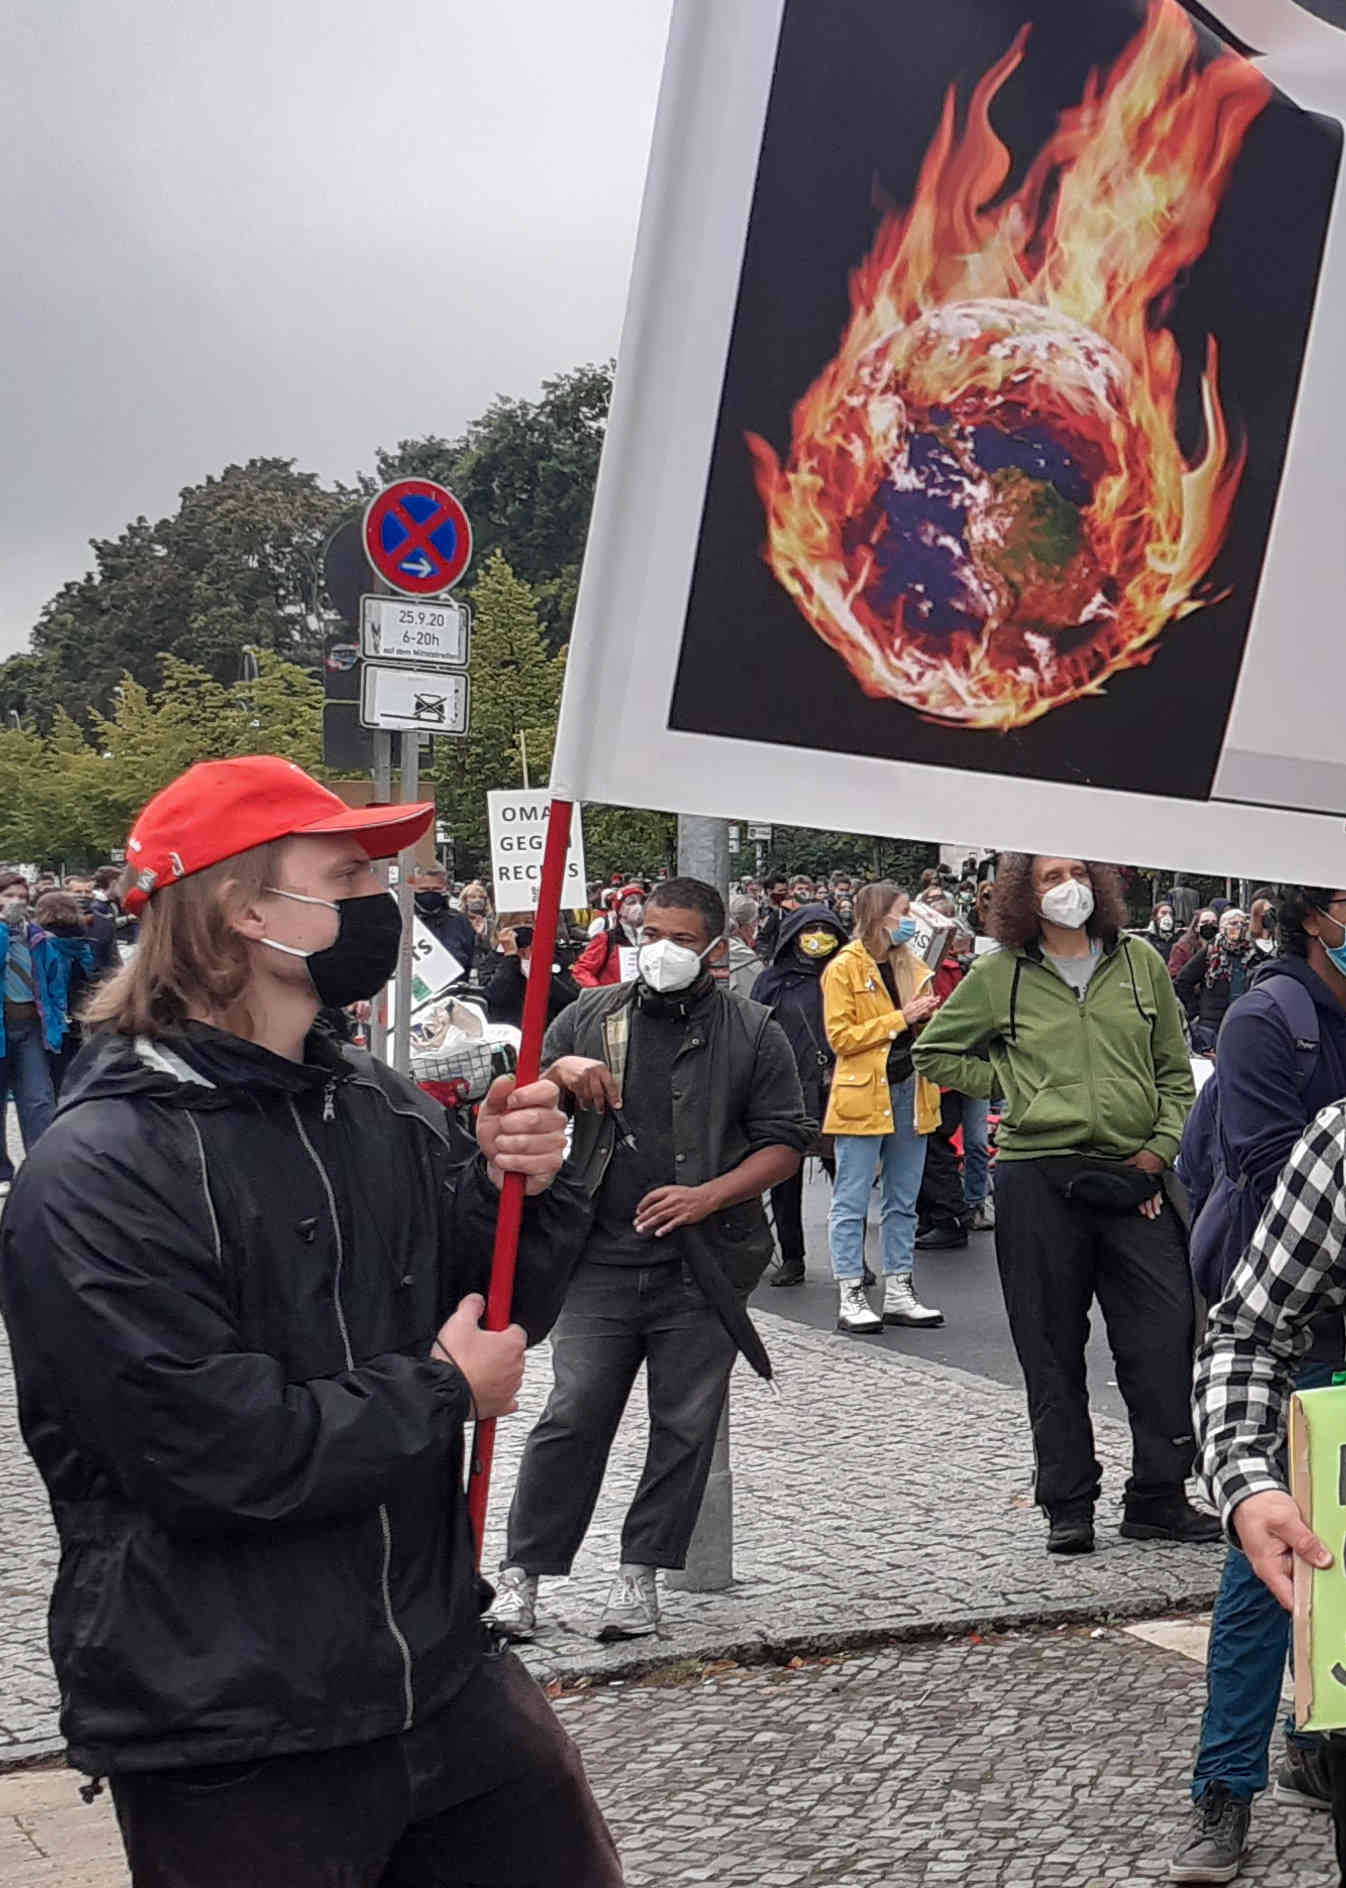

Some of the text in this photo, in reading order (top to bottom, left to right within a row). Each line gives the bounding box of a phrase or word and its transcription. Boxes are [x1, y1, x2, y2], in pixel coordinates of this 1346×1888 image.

[399, 610, 445, 627] 25.9.20
[402, 629, 440, 647] 6-20h
[499, 862, 578, 881] RECS
